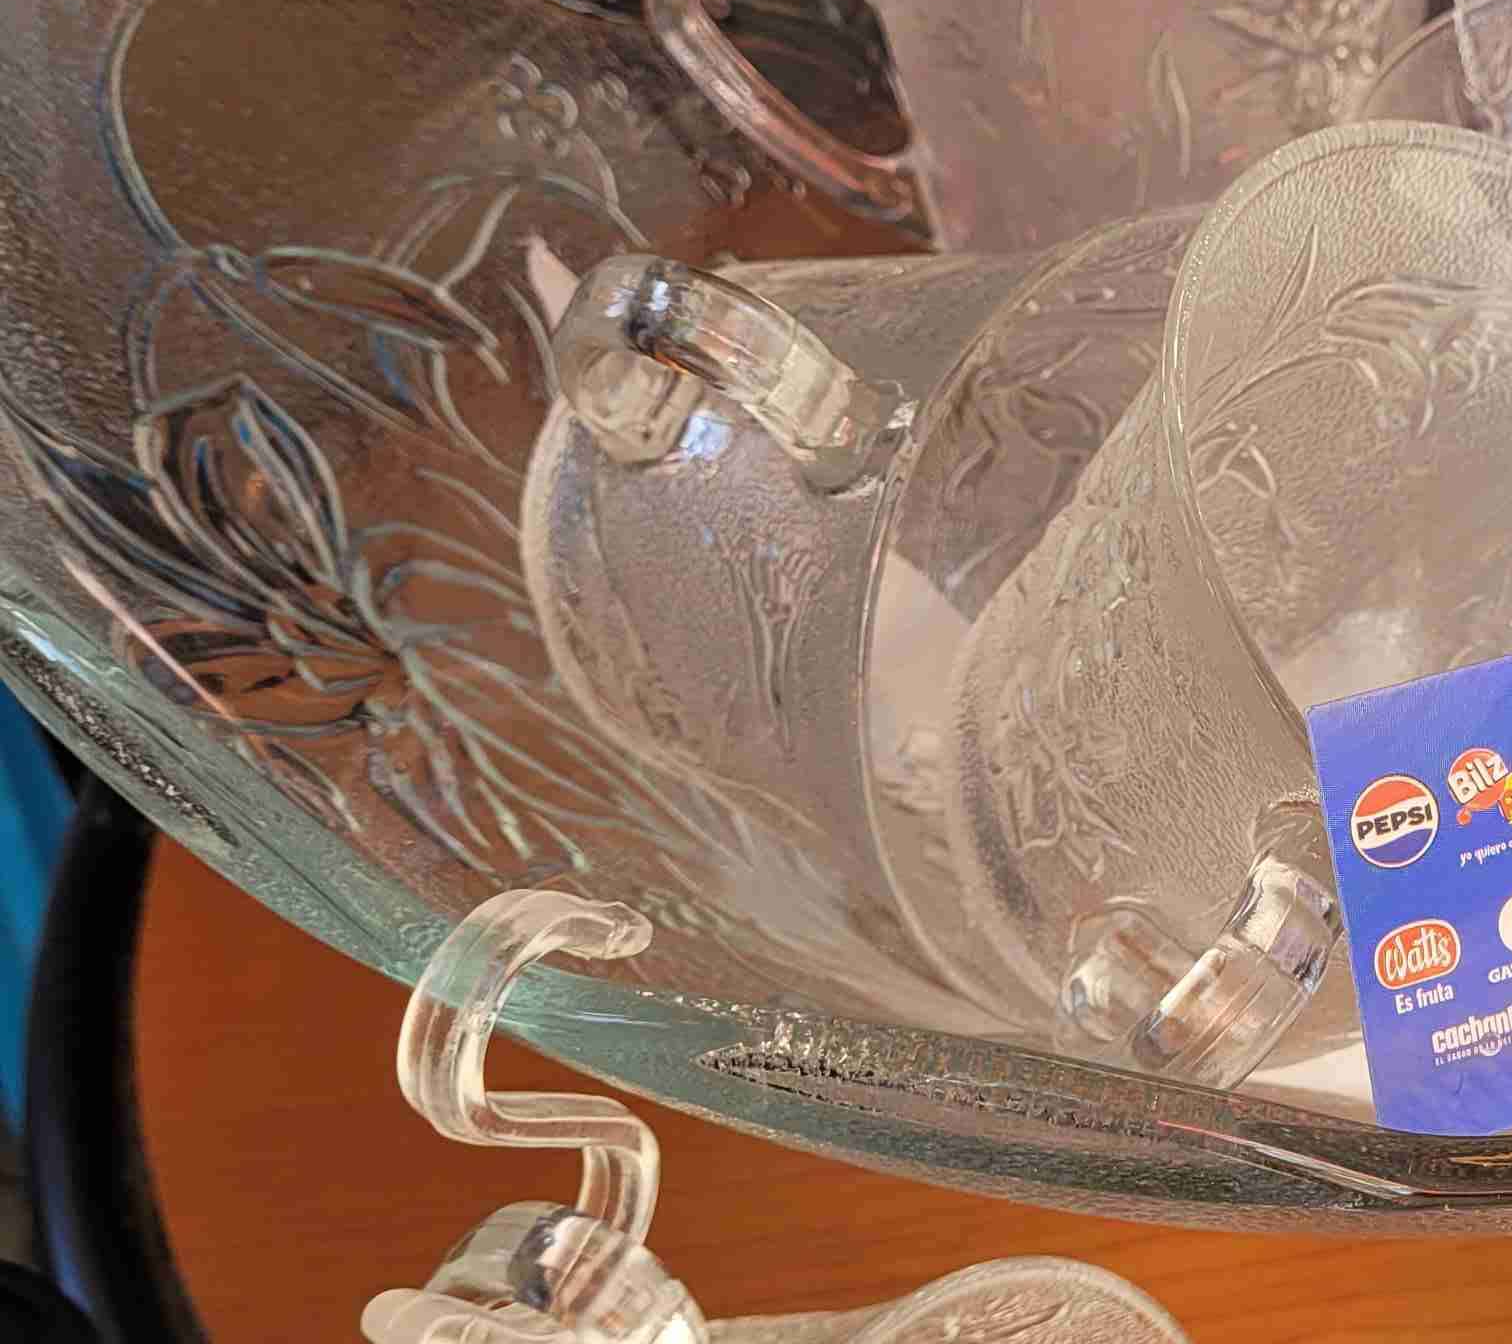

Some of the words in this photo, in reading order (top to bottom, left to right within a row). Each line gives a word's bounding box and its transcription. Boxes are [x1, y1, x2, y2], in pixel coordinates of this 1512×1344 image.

[1448, 754, 1511, 804] Bilz
[1356, 803, 1433, 841] PEPSI
[1394, 993, 1414, 1015] Es
[1415, 983, 1454, 1009] fruta
